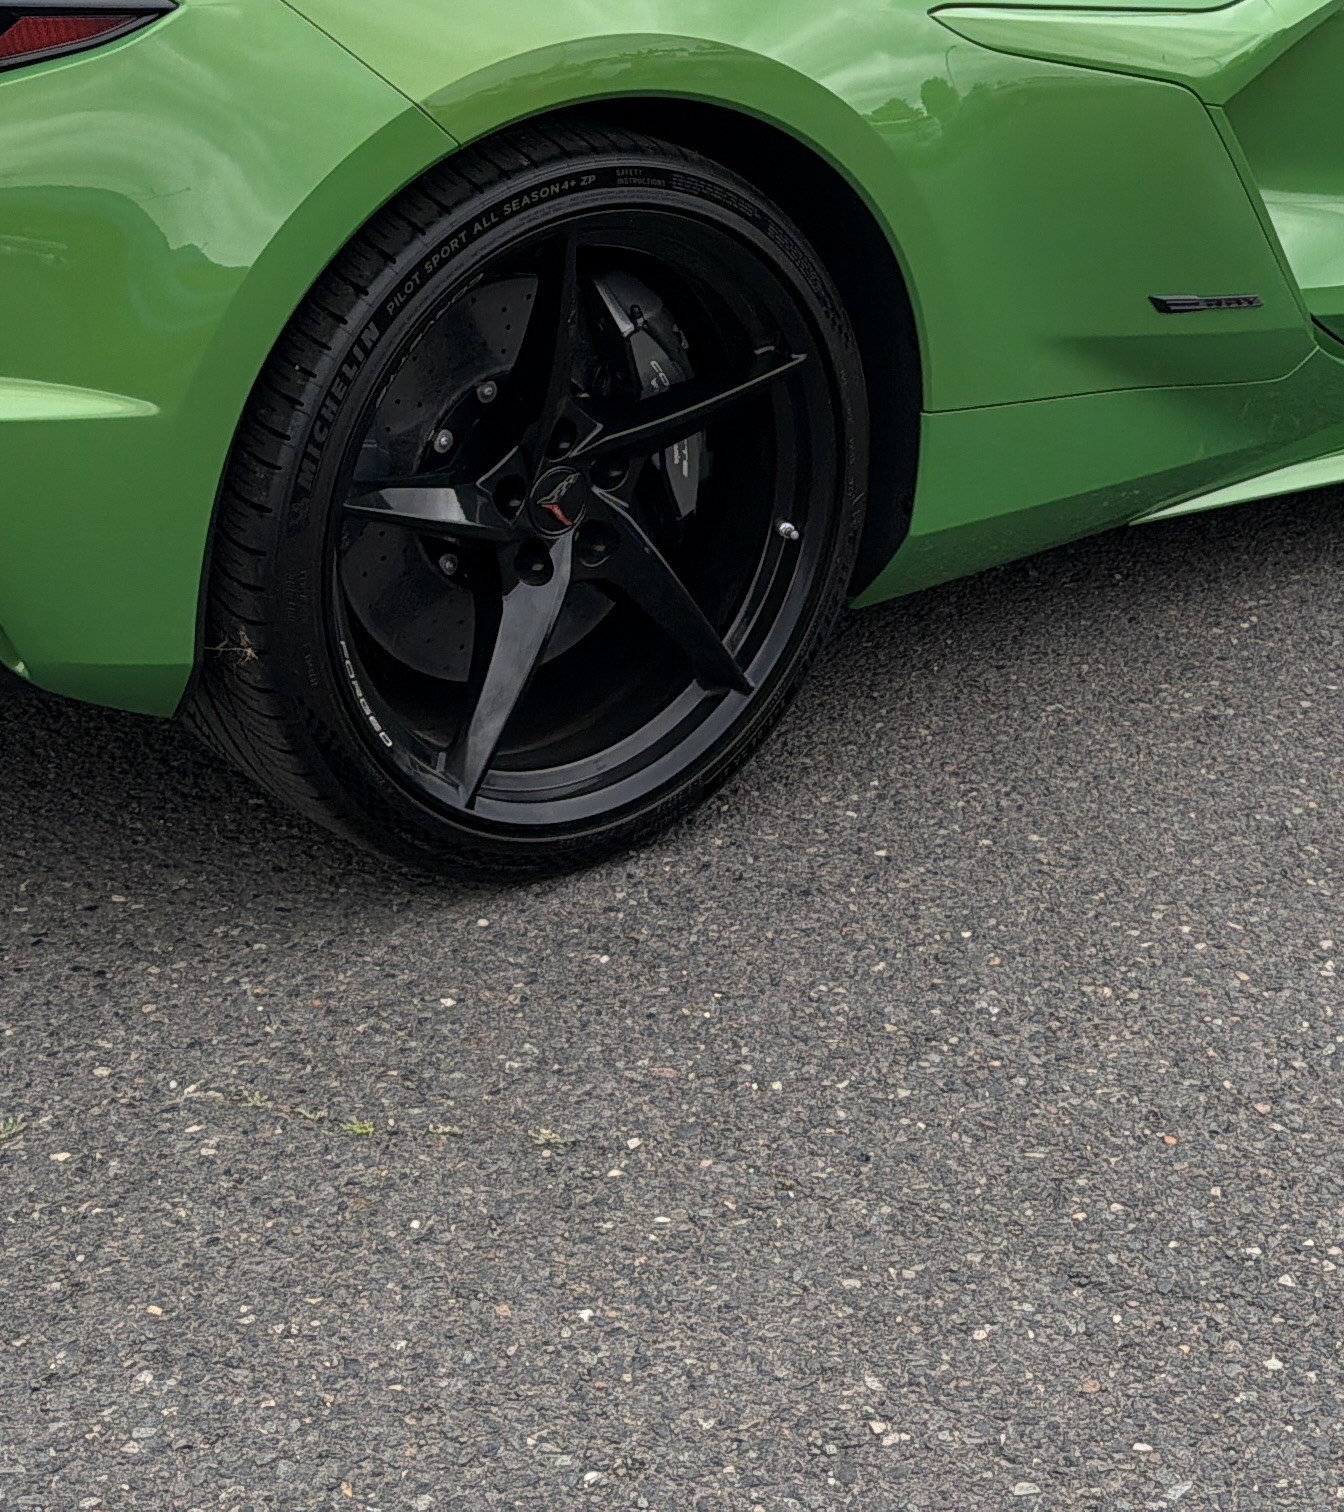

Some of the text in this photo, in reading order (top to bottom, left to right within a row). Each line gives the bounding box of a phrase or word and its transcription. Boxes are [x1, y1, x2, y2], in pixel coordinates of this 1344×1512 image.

[296, 320, 380, 488] MICHELIN
[386, 271, 423, 316] PILOT
[424, 232, 468, 273] SPORT
[472, 212, 500, 236] ALL
